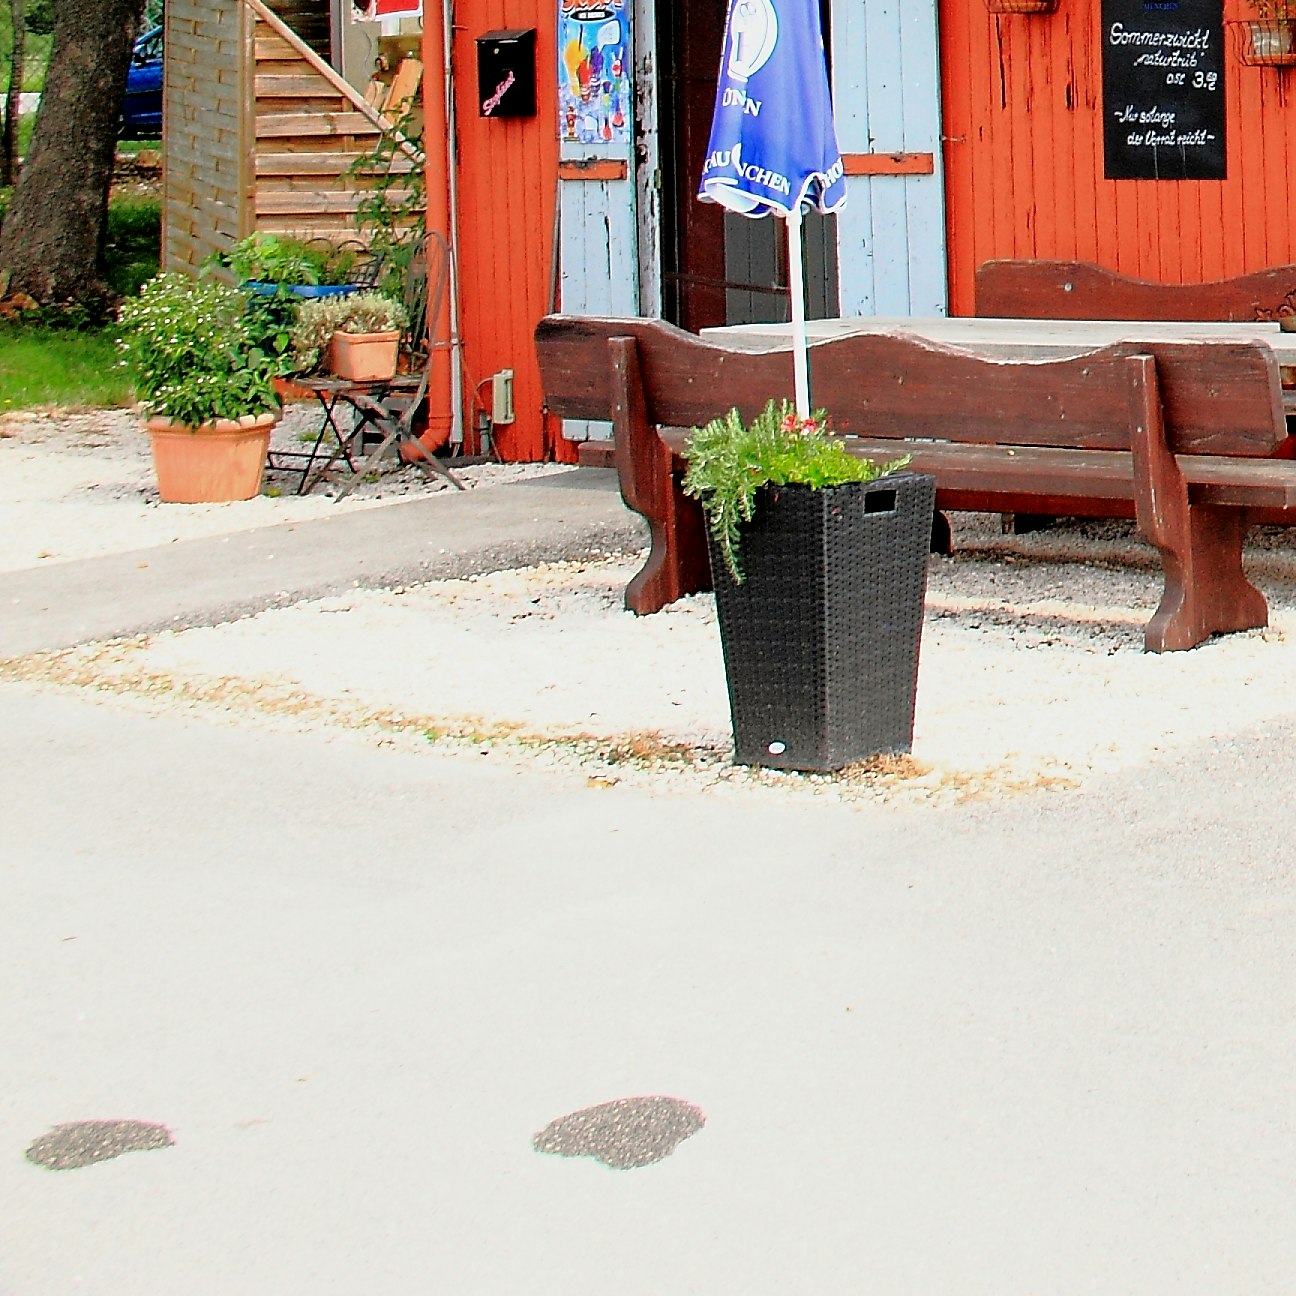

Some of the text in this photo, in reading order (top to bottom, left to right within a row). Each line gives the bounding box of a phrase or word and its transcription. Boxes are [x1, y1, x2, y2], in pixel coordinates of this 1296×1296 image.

[1139, 105, 1176, 128] solange
[1127, 132, 1144, 145] der
[1145, 129, 1176, 146] Vorrat
